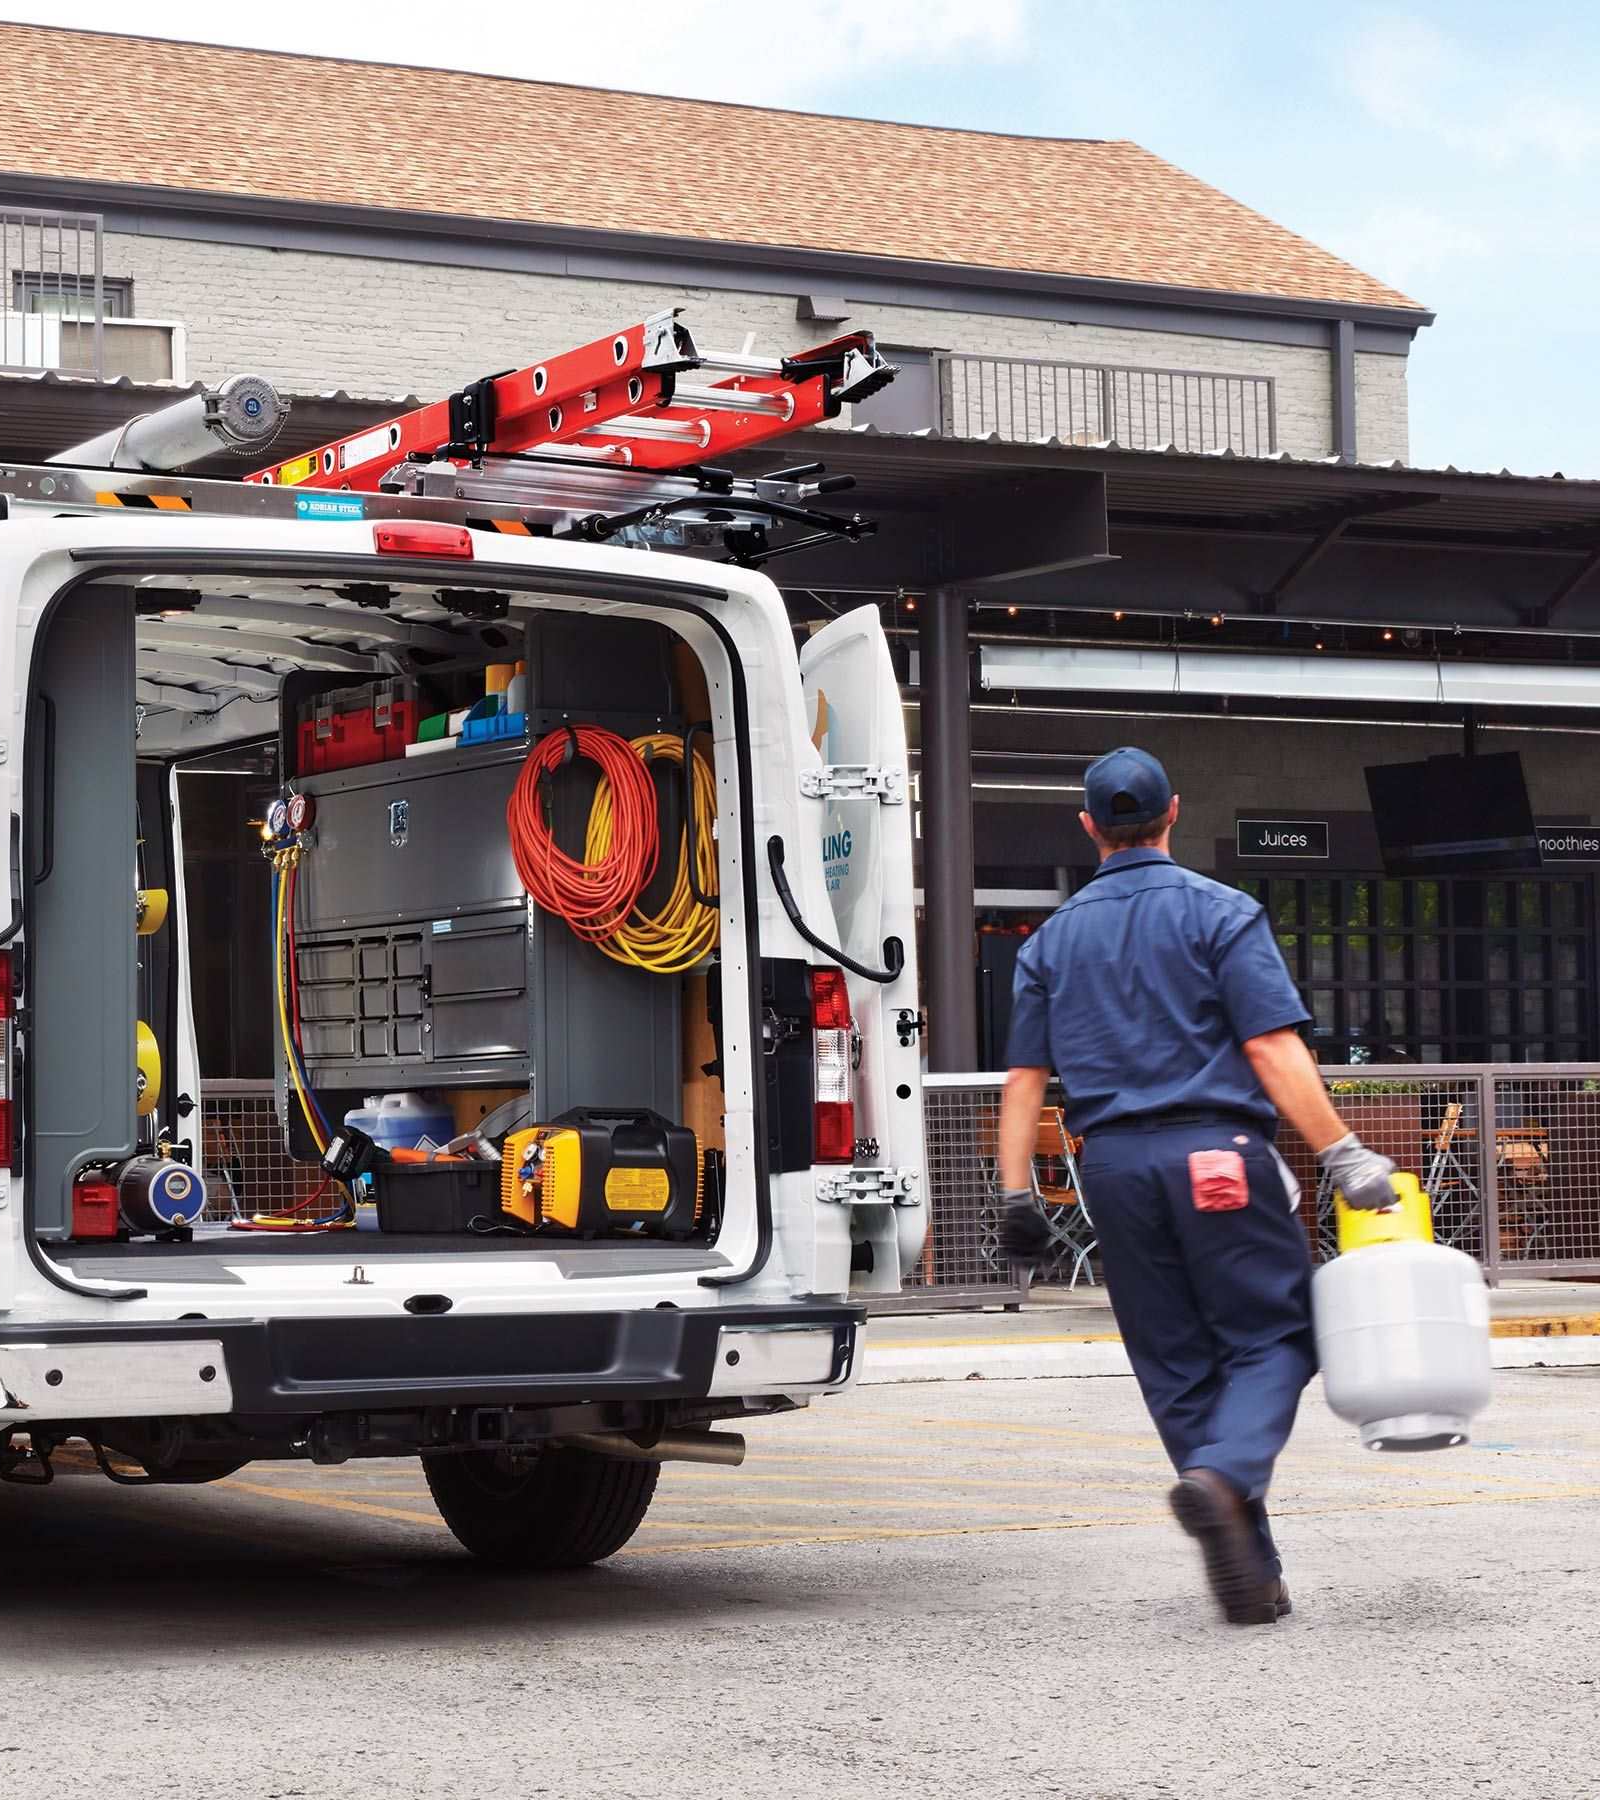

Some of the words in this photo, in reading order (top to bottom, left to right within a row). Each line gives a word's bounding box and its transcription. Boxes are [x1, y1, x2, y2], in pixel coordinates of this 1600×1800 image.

[309, 503, 338, 512] ADRIAN
[338, 504, 361, 513] STEEL
[822, 830, 852, 862] LING
[1259, 829, 1308, 847] Juices
[1539, 835, 1600, 851] oothies
